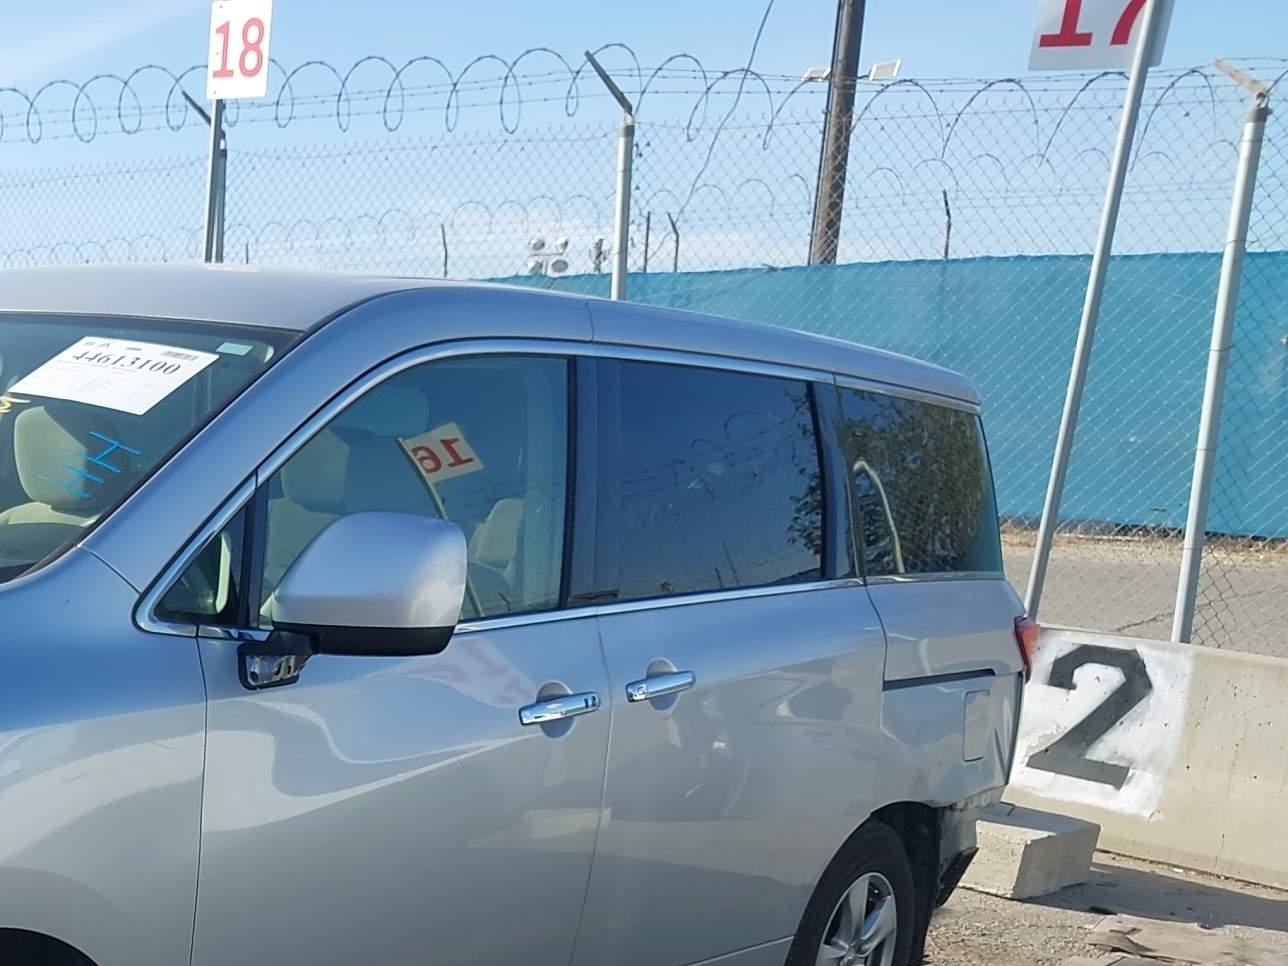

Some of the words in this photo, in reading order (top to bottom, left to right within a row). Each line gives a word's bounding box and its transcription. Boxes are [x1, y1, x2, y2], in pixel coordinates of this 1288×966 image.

[212, 16, 265, 79] 18
[72, 350, 182, 375] 44613100
[1015, 643, 1154, 791] 2
